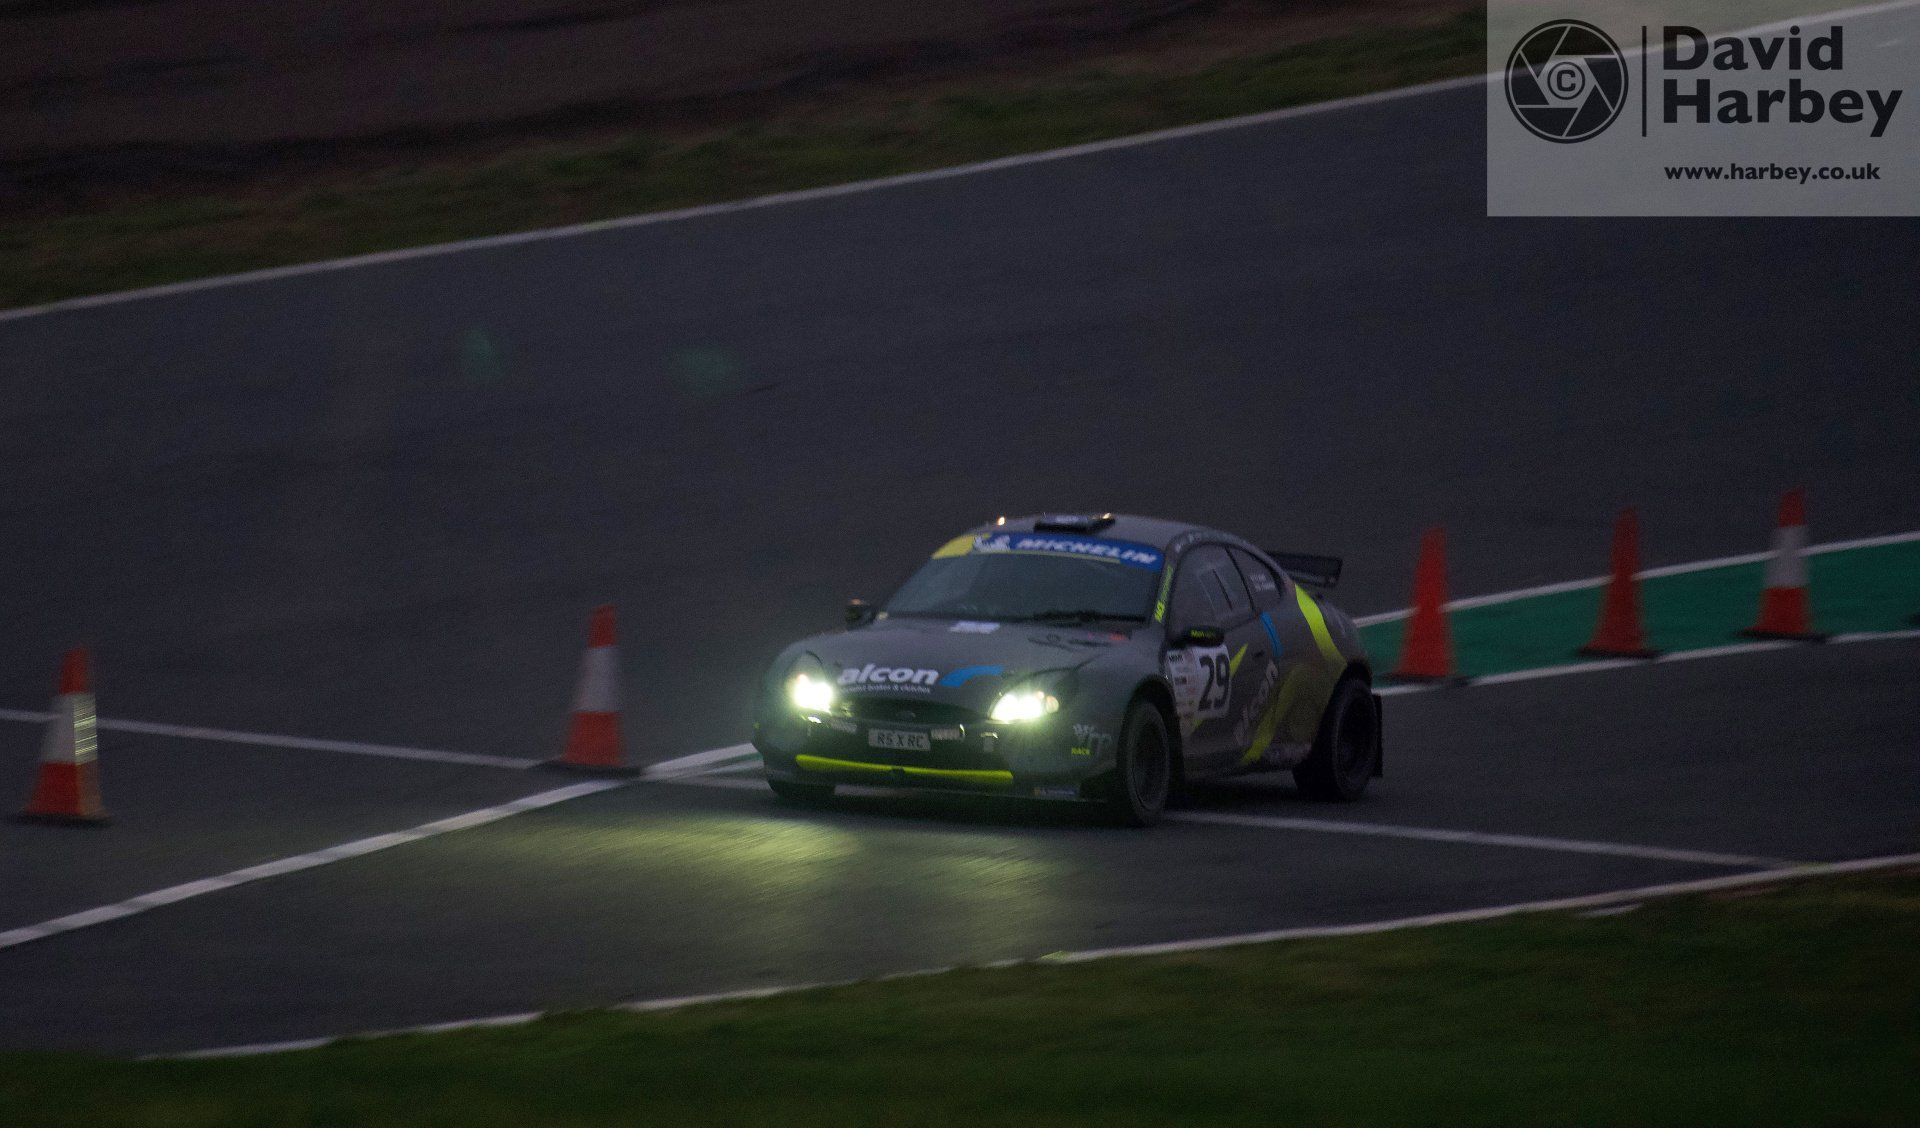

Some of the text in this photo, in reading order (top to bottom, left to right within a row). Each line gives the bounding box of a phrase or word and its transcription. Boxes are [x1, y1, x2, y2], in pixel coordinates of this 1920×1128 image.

[1017, 538, 1157, 564] MICHELIN
[839, 663, 939, 686] alcon
[1198, 653, 1231, 711] 29
